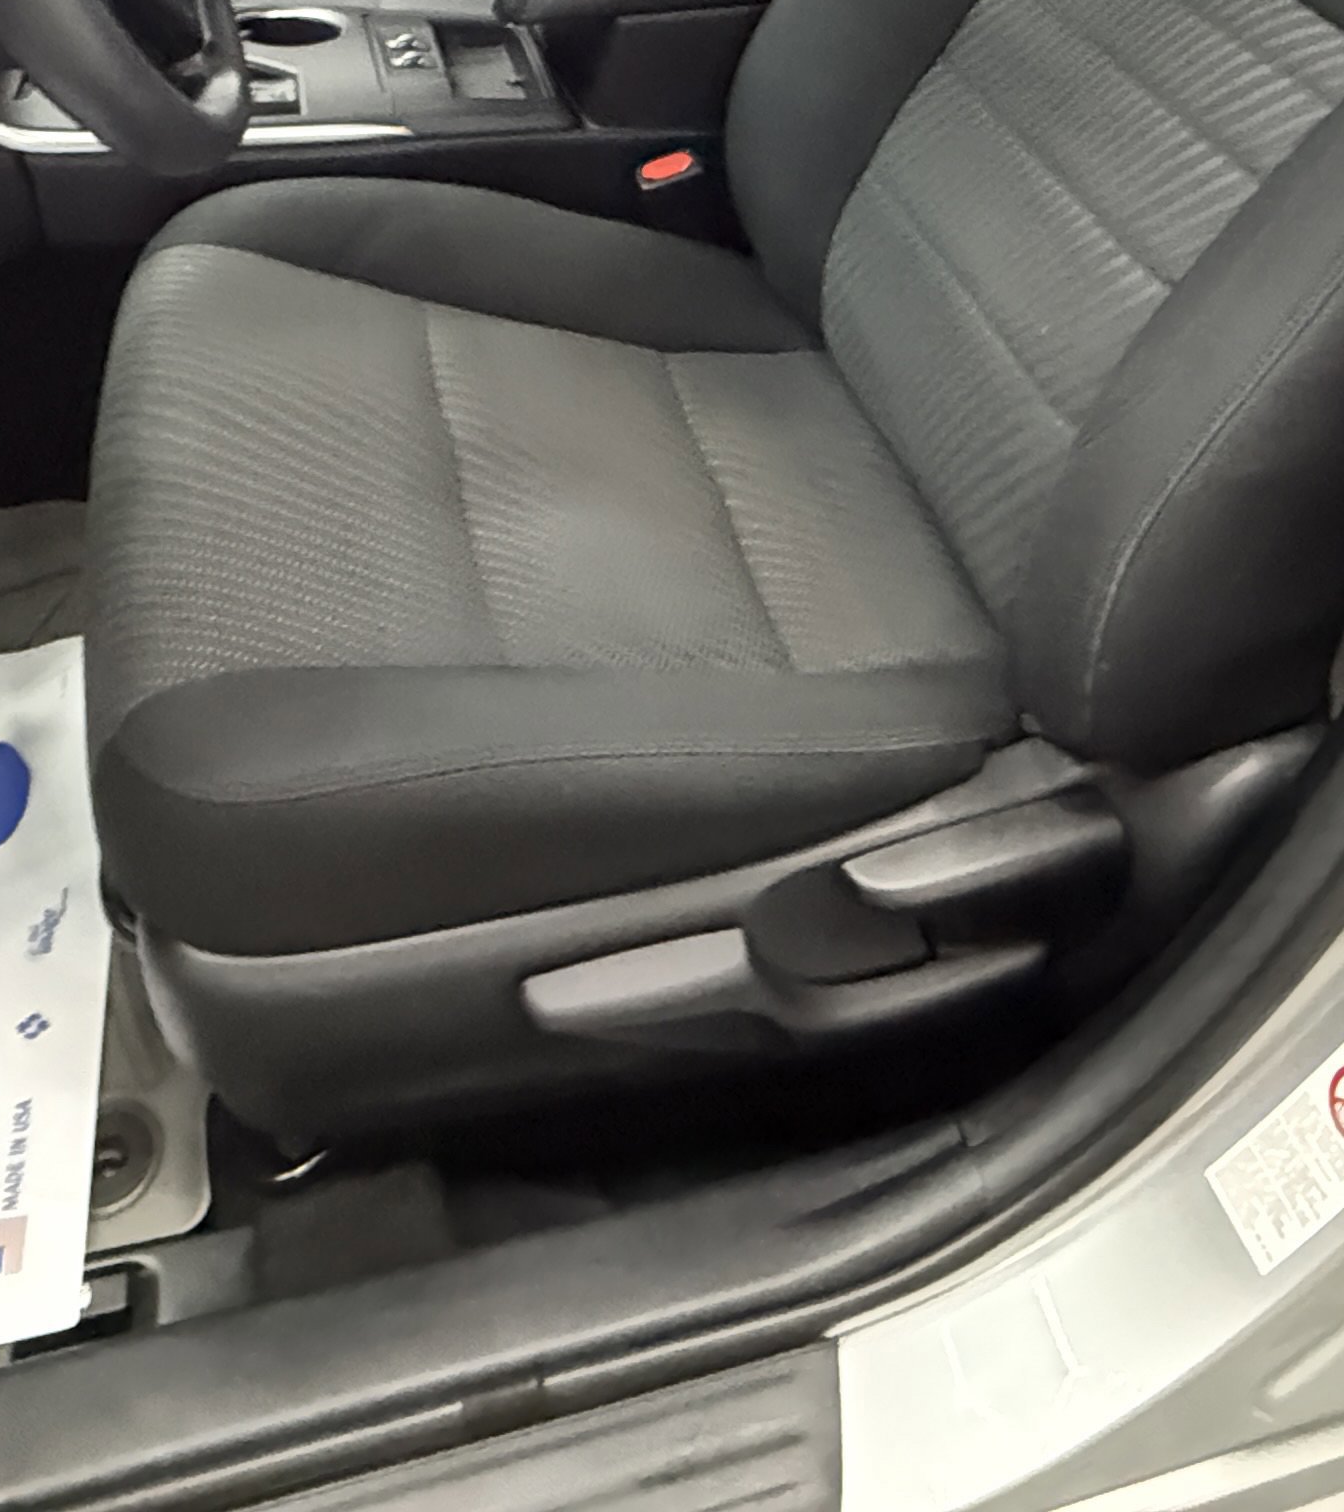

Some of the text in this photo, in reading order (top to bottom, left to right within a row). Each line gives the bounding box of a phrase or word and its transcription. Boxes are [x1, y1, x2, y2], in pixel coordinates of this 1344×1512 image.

[1, 1096, 33, 1211] MADE IN USA
